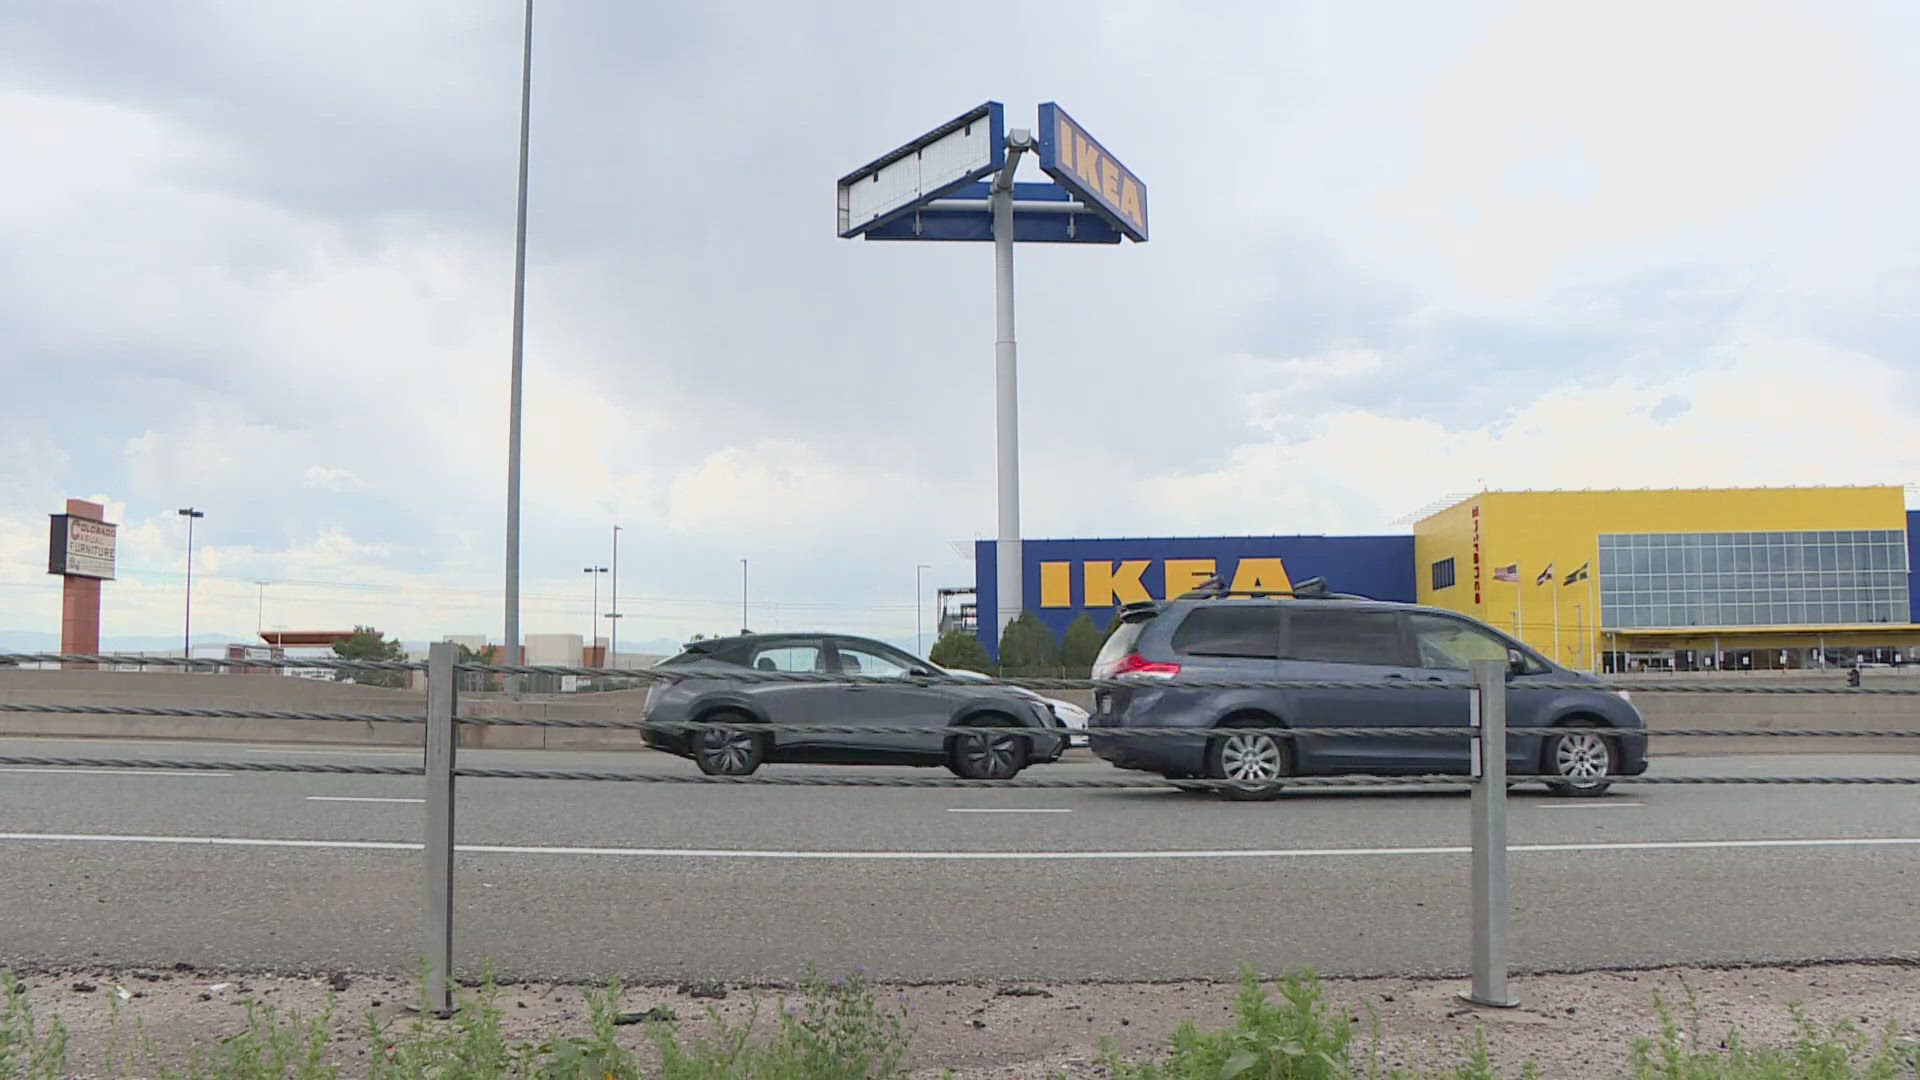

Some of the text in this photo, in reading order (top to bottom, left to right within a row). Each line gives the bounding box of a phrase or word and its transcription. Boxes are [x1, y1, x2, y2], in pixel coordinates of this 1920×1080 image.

[1060, 119, 1143, 228] IKEA
[71, 519, 116, 540] COLORADO
[69, 540, 115, 558] FURNITURE
[1039, 557, 1297, 608] IKEA
